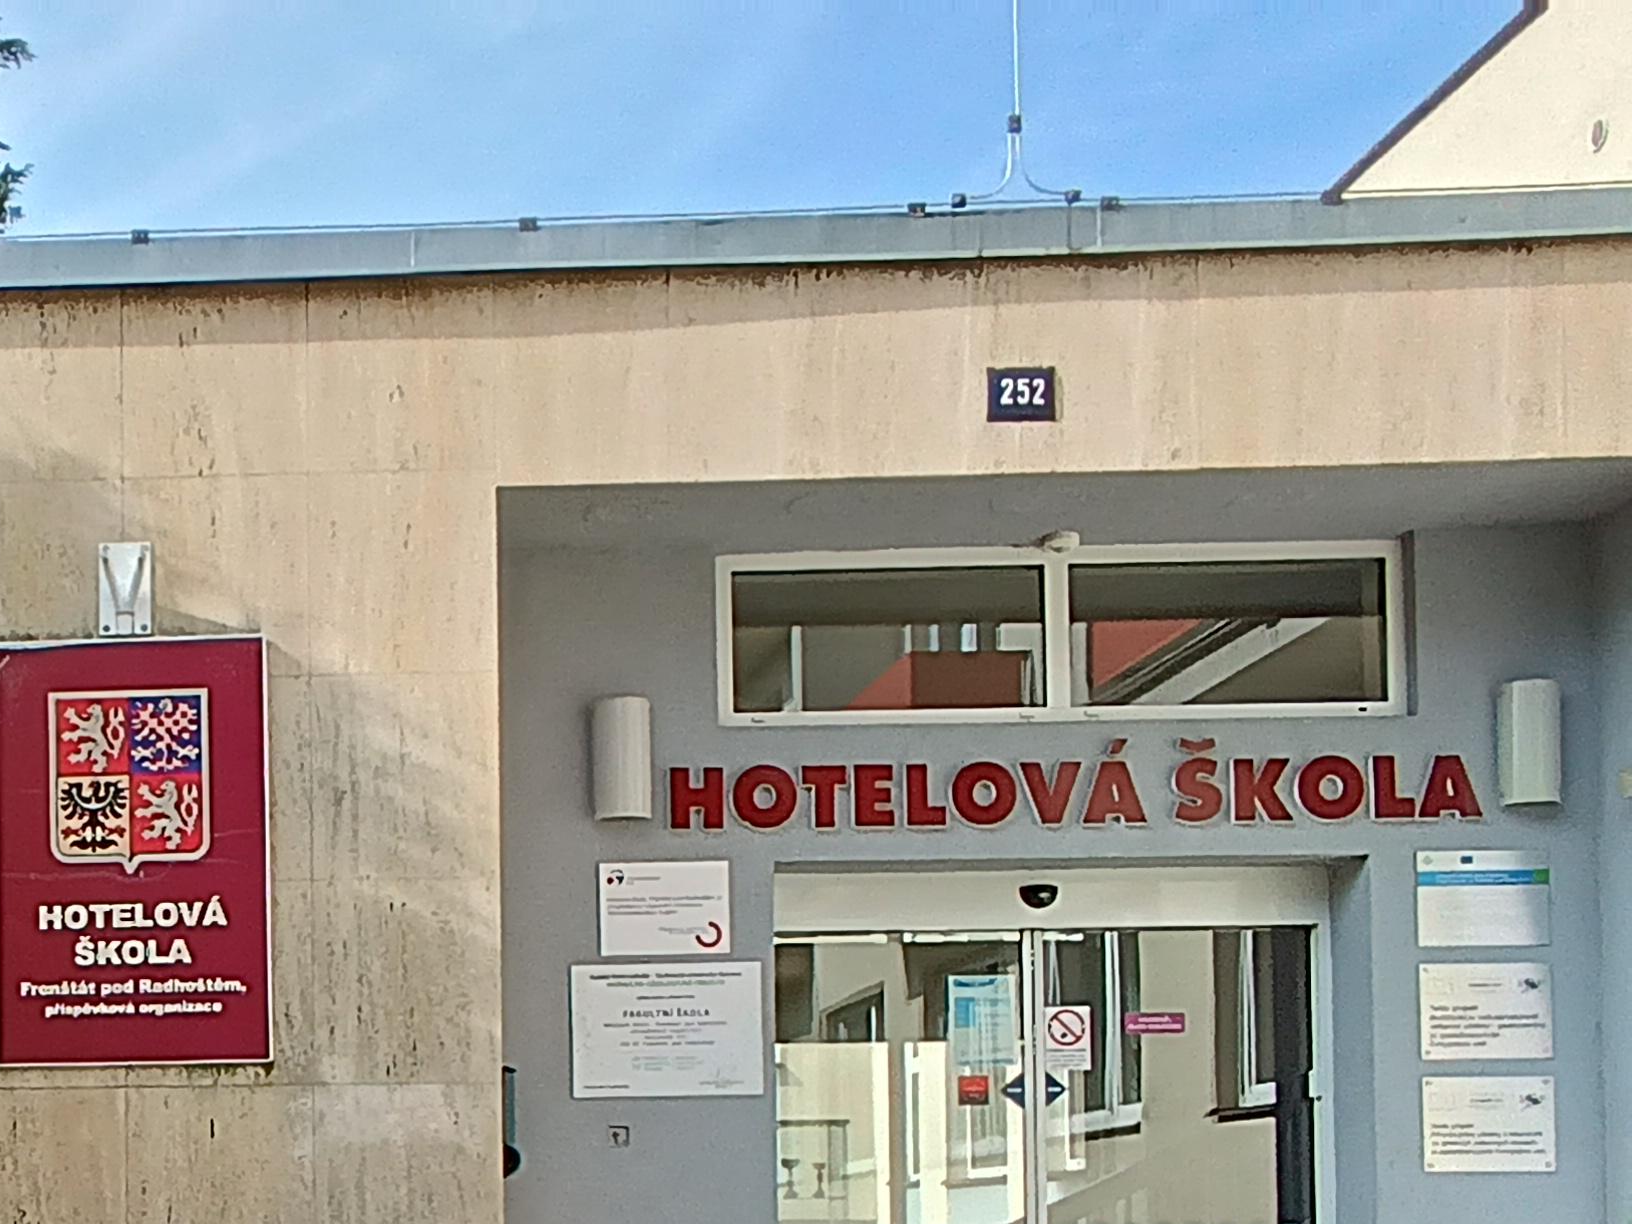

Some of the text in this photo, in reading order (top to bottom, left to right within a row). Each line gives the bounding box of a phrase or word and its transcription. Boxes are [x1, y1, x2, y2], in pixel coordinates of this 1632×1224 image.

[1000, 377, 1045, 406] 252
[669, 737, 1484, 831] HOTELOVÁ ŠKOLA
[38, 895, 228, 930] HOTELOVÁ
[74, 935, 192, 966] ŠKOLA
[100, 979, 134, 997] pod
[139, 1000, 223, 1016] organizace
